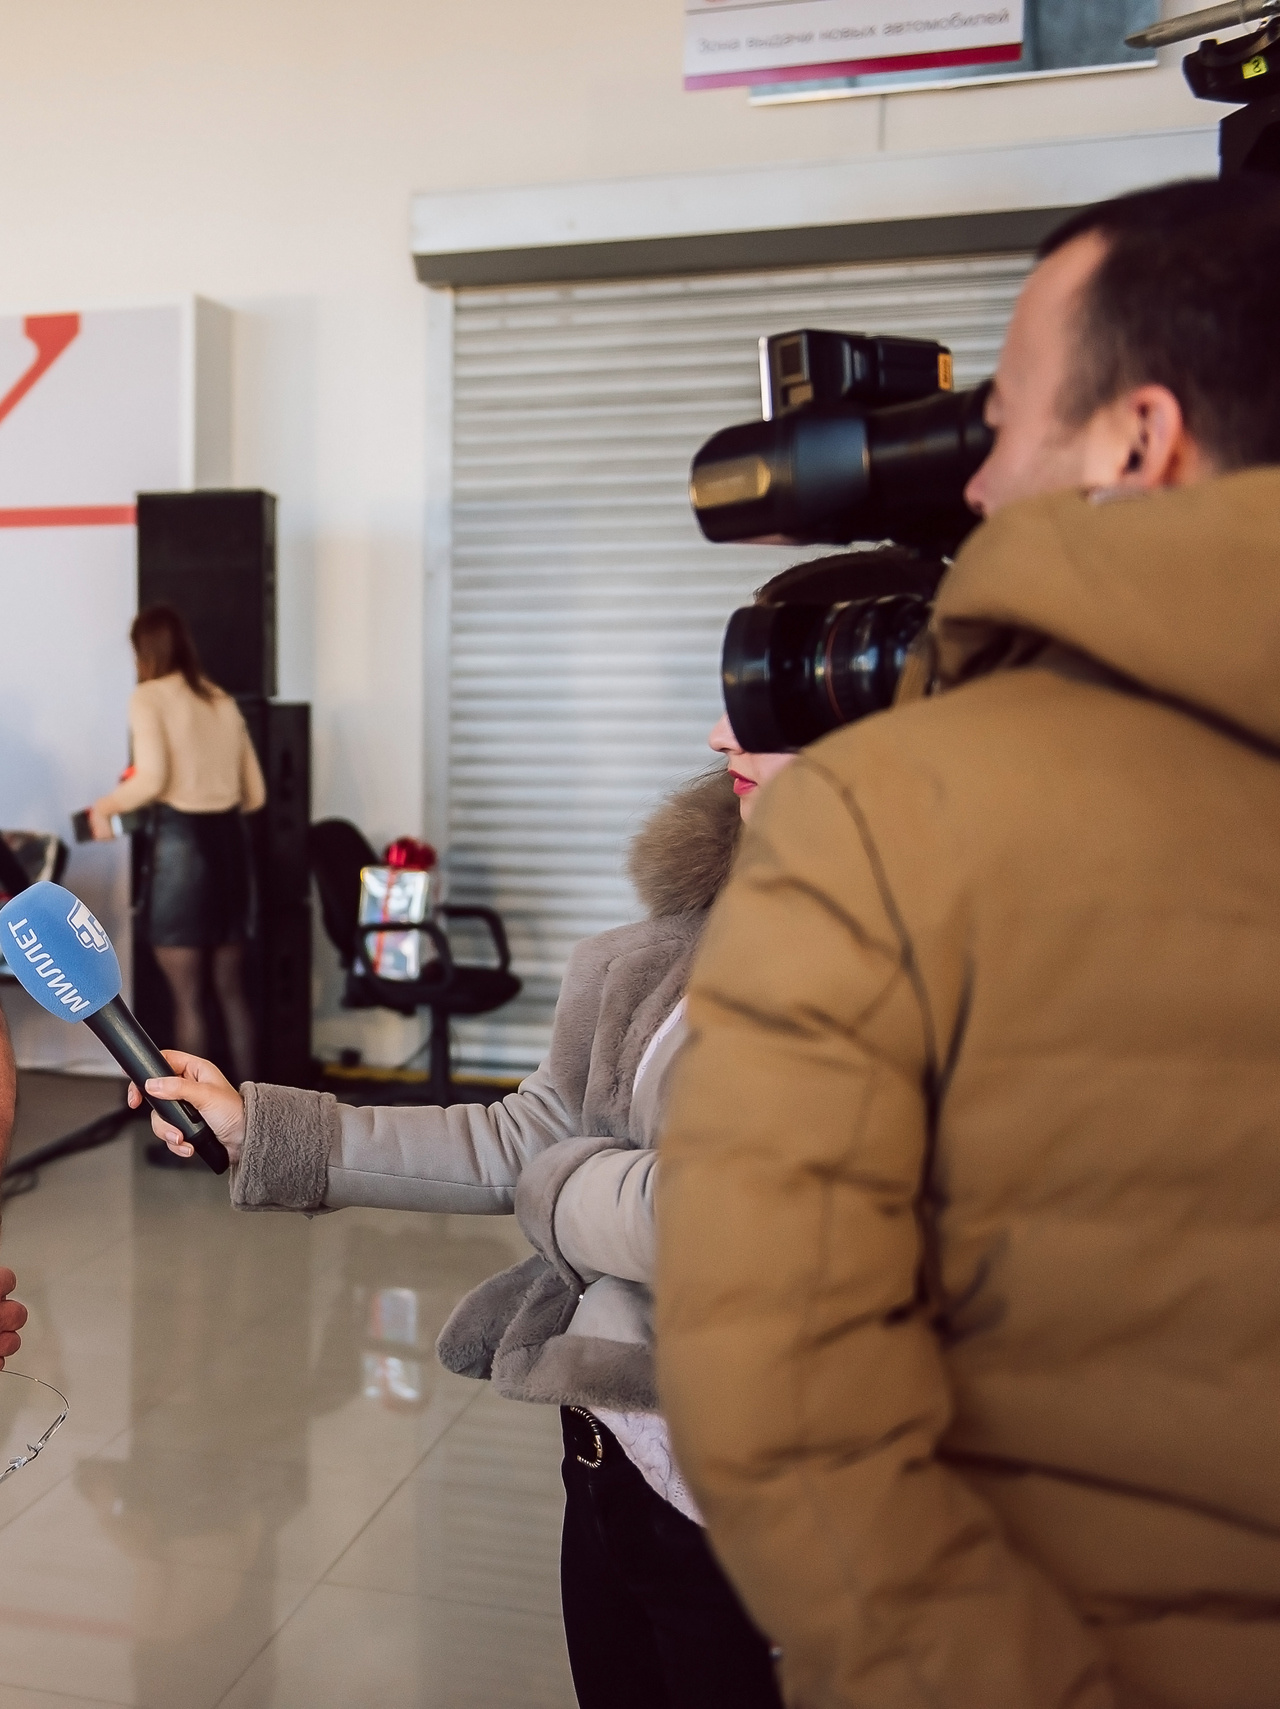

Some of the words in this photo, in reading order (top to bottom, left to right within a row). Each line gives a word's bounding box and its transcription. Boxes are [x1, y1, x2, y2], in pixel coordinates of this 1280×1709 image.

[698, 37, 740, 54] Зона
[745, 31, 815, 50] выдачи
[819, 25, 877, 41] новых
[882, 8, 1010, 36] автомобилей
[7, 917, 91, 1013] МИЛЛЕТ
